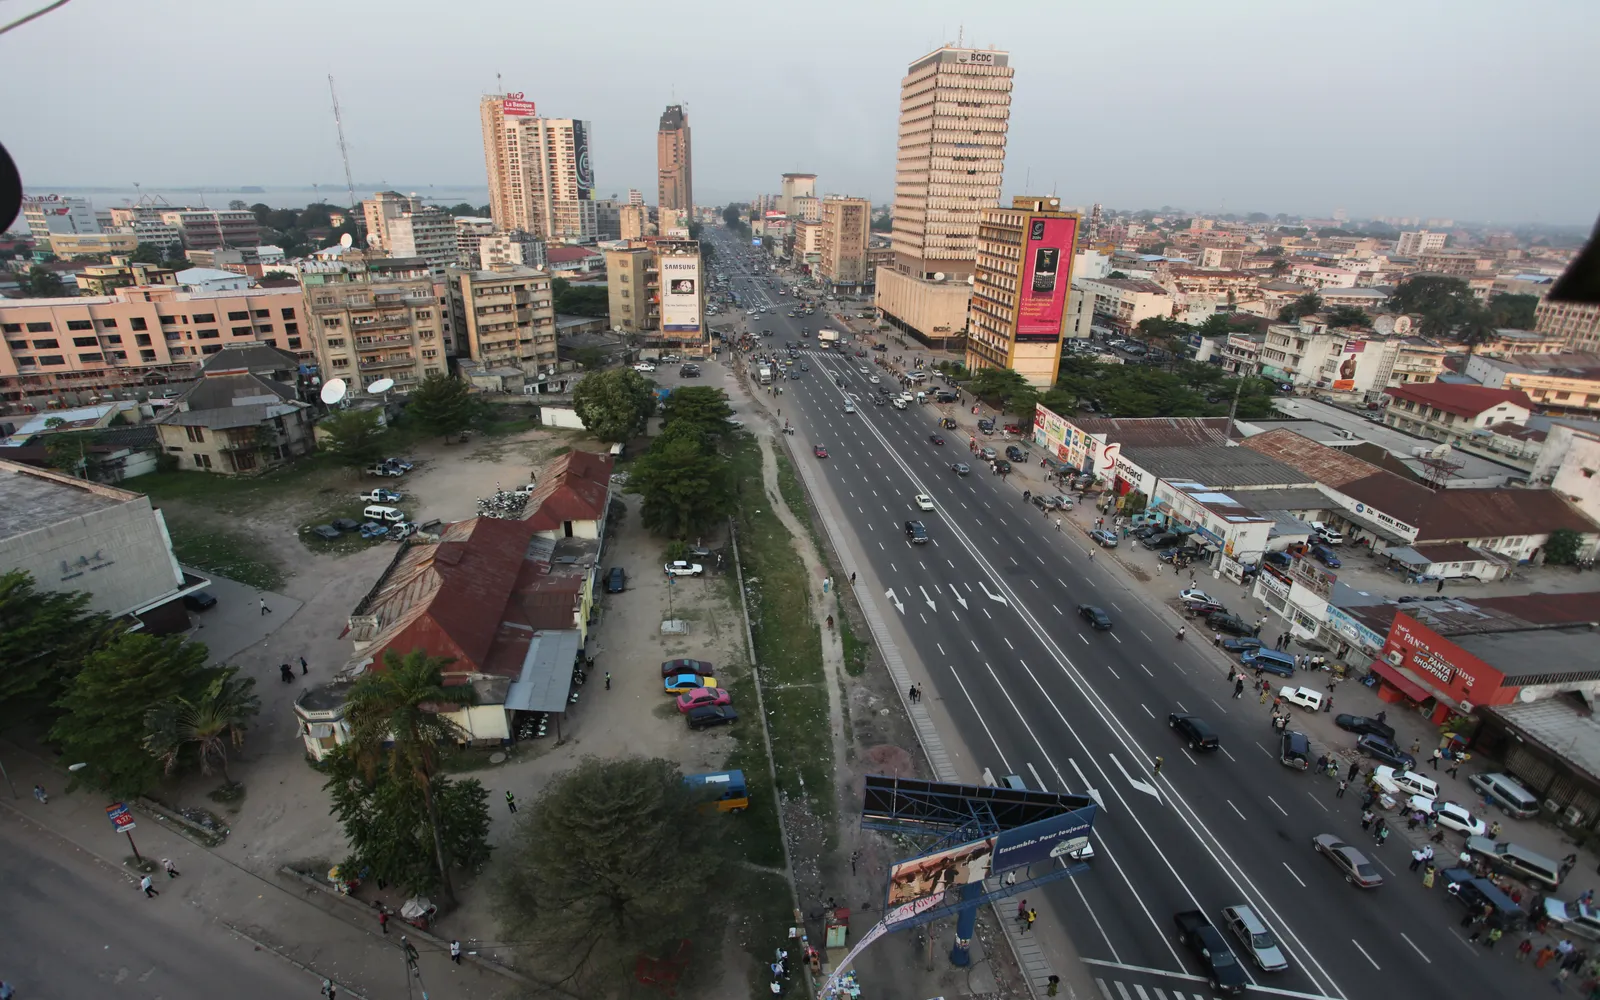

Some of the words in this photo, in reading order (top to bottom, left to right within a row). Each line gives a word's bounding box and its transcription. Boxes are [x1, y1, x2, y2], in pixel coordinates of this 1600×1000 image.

[971, 53, 992, 62] BCDC
[1103, 445, 1142, 482] Standard
[1412, 655, 1449, 682] SHOPPING
[1427, 656, 1451, 676] PANTA
[999, 839, 1037, 854] Ensemble.
[1039, 832, 1057, 842] Pour
[1058, 823, 1090, 837] toujours.
